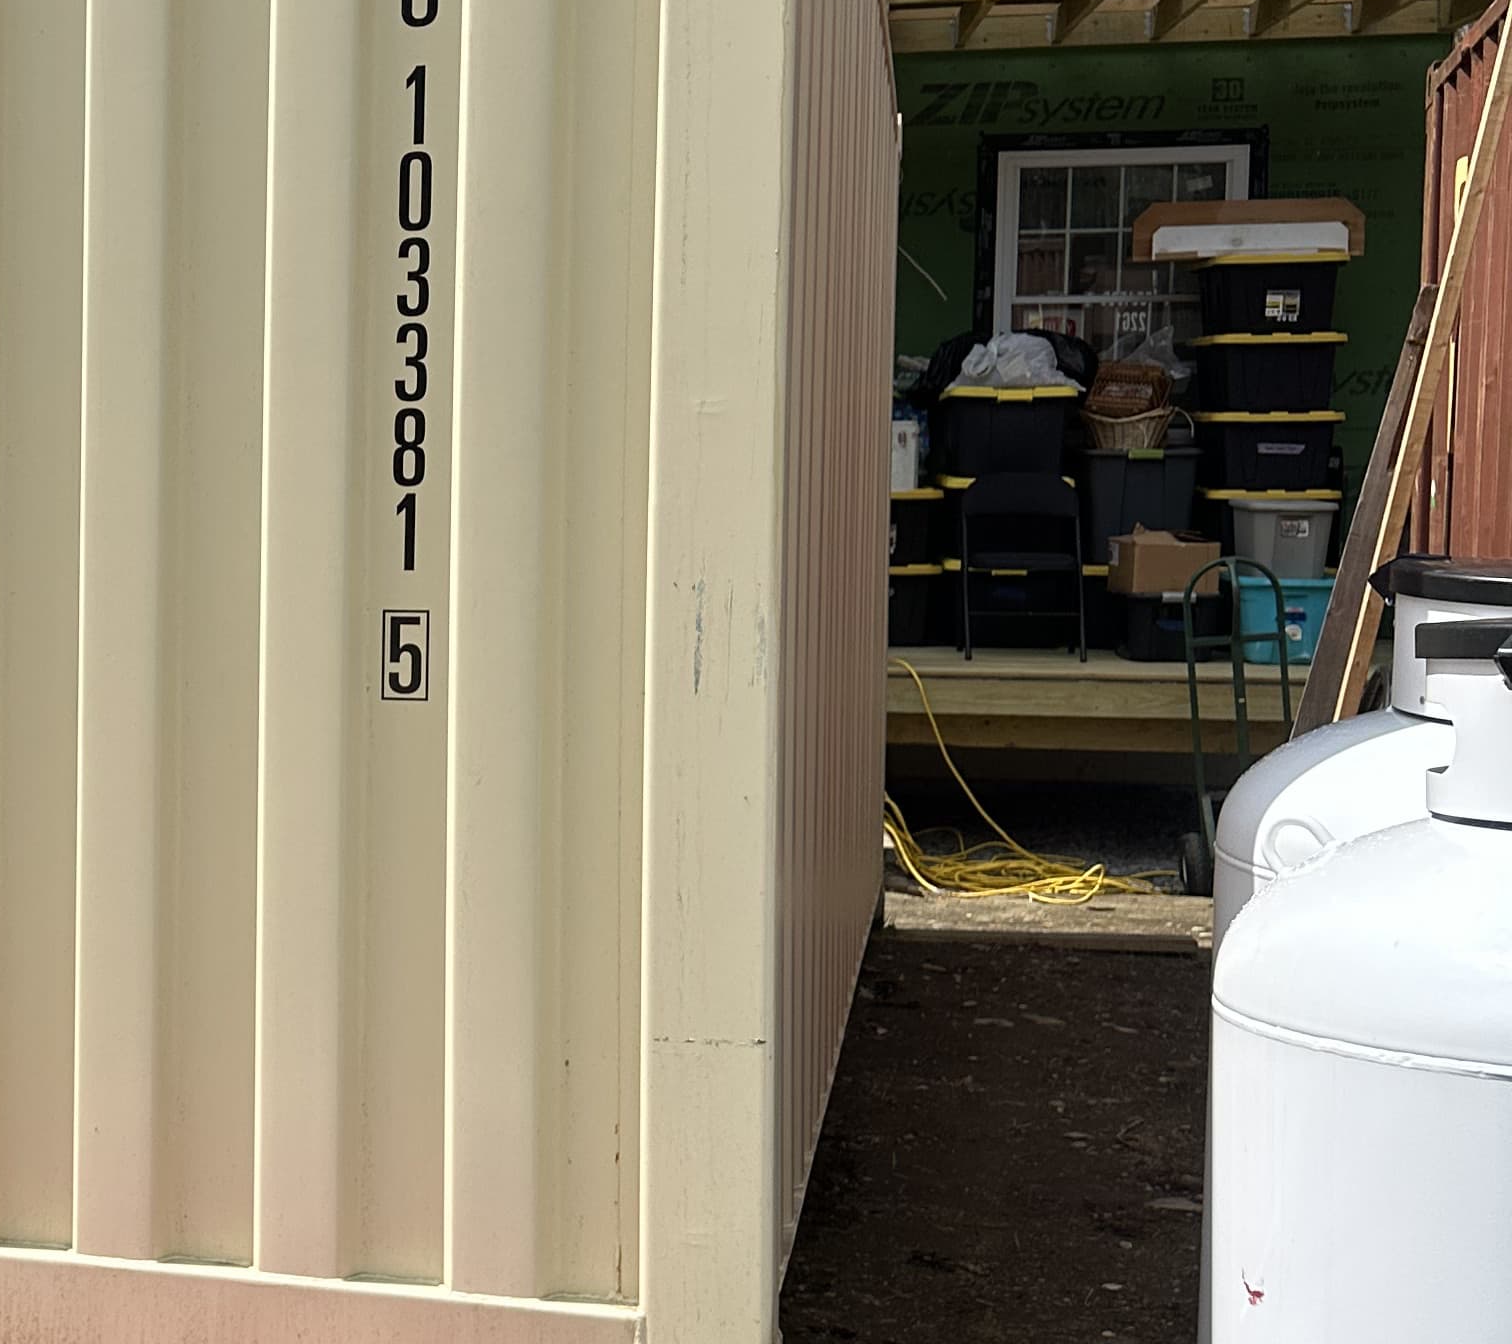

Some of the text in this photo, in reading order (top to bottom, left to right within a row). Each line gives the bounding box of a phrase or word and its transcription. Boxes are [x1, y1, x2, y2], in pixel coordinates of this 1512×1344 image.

[904, 80, 1166, 127] ZIPsystem
[392, 65, 433, 571] 103381
[388, 615, 422, 694] 5
